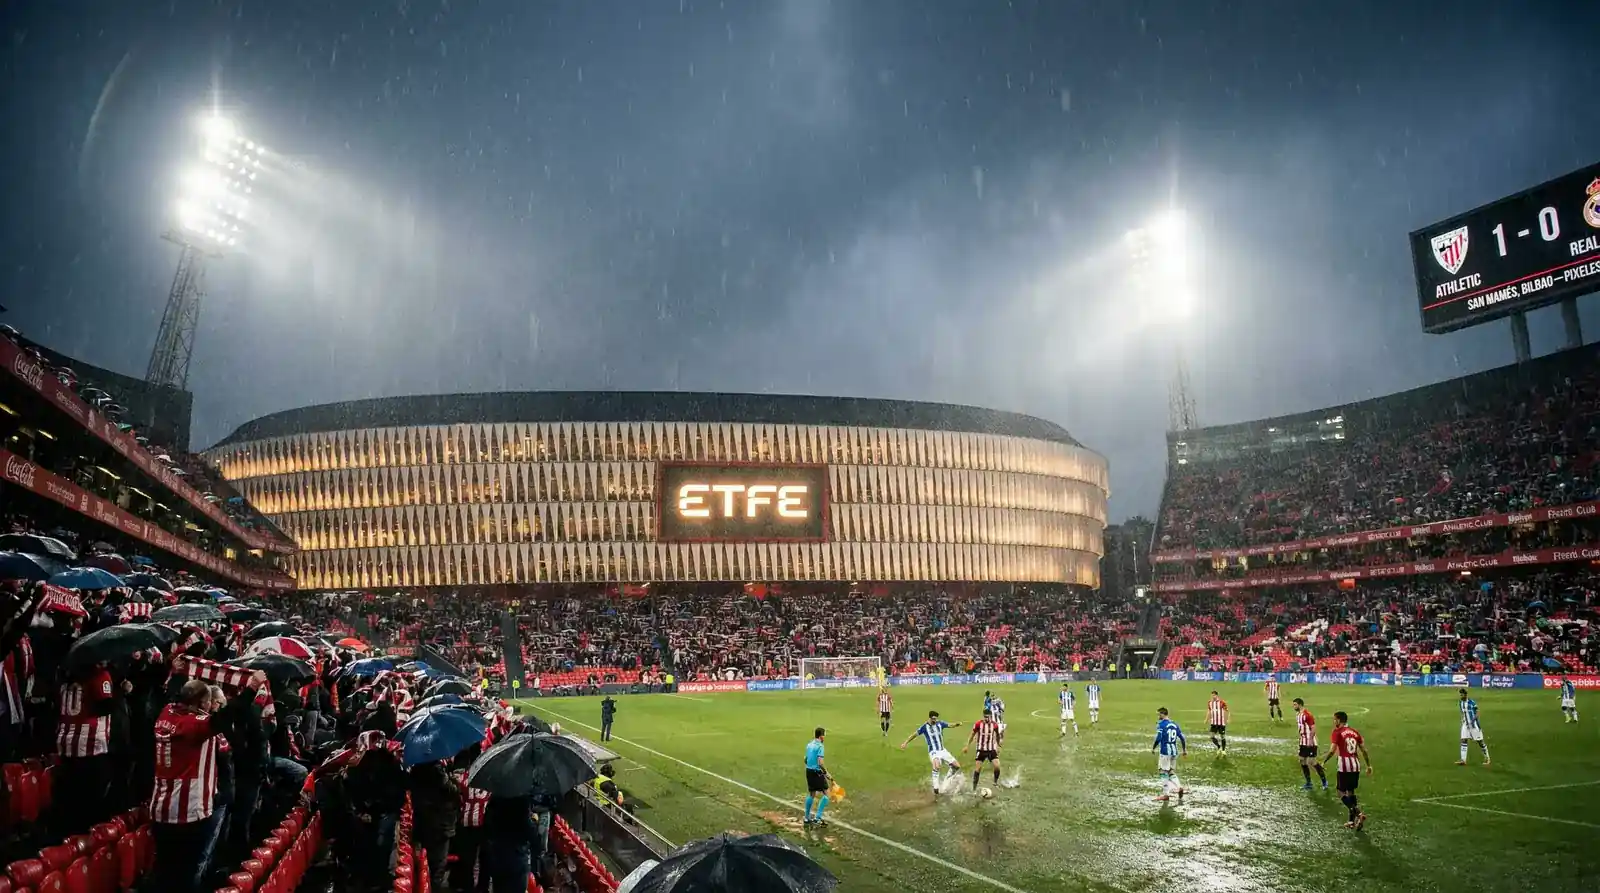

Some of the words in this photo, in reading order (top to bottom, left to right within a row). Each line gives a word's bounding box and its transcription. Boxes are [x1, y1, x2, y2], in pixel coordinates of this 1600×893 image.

[1492, 223, 1507, 257] 1
[1538, 206, 1561, 242] 0
[1569, 235, 1600, 256] REAL
[1435, 273, 1482, 298] ATHLETIC
[1467, 296, 1485, 311] SAN
[1485, 285, 1520, 304] MAMÉS,
[679, 484, 808, 518] ETFE
[1166, 728, 1177, 743] 19
